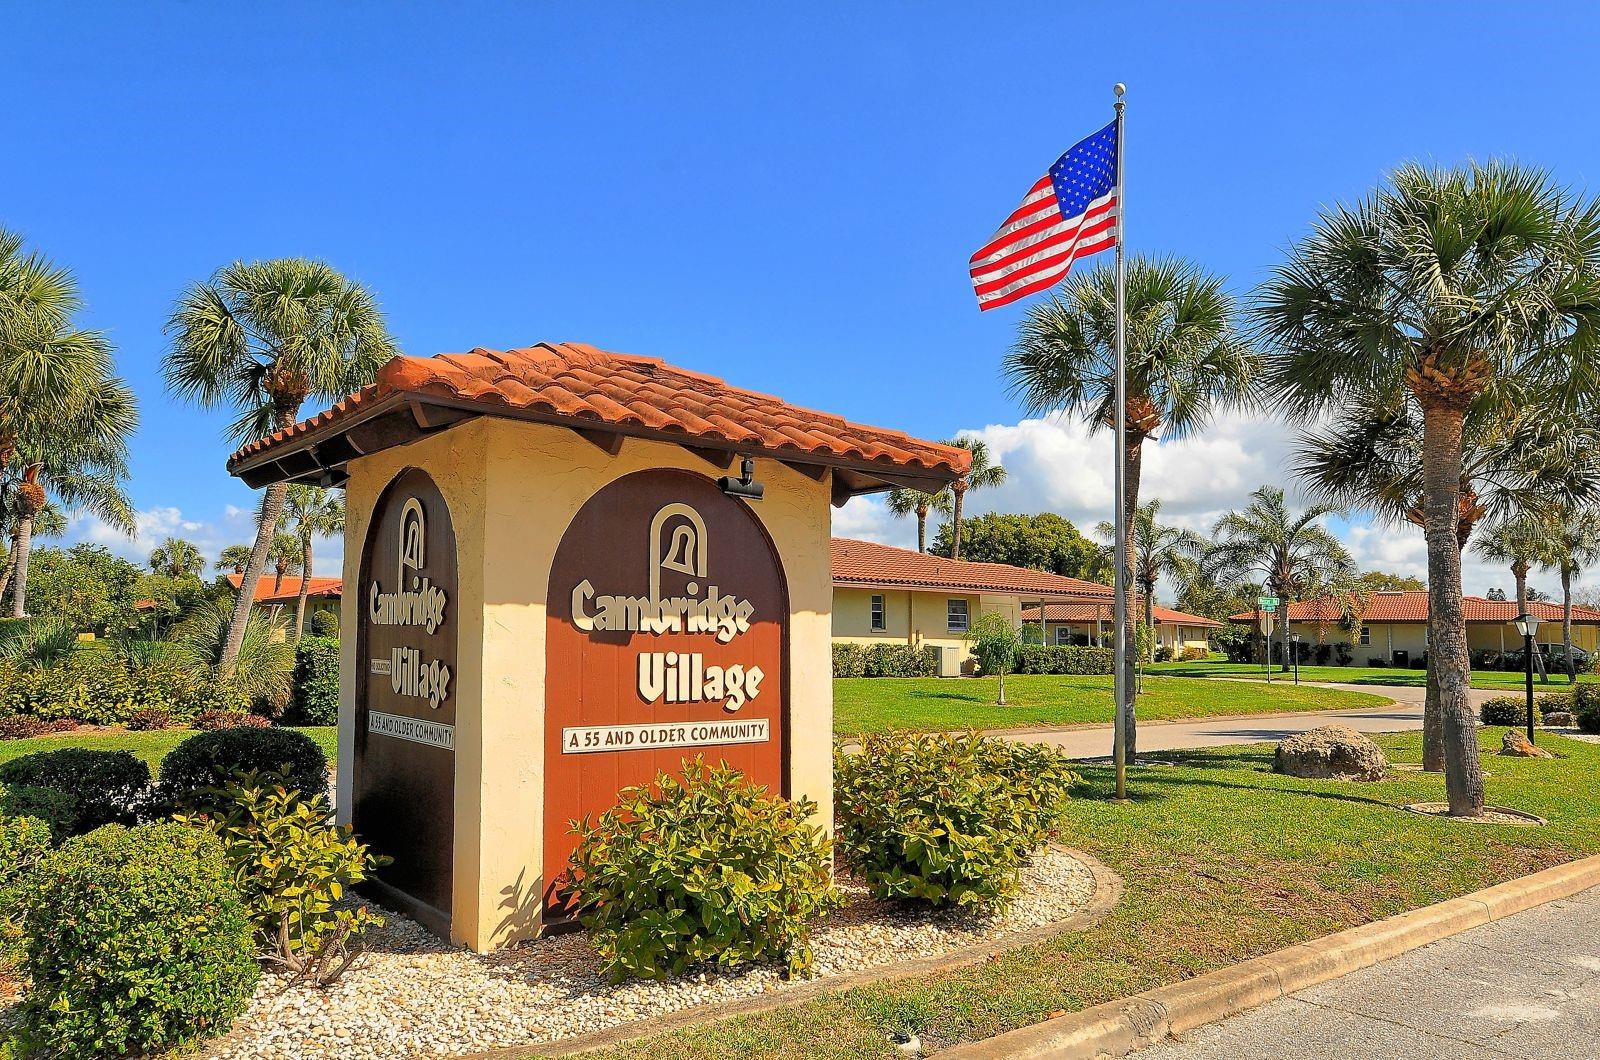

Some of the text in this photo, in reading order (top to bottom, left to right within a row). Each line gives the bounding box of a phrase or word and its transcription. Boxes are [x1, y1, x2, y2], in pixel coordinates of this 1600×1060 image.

[370, 576, 446, 635] Cambridge
[572, 579, 754, 643] Cambridge
[392, 646, 450, 709] Village
[638, 651, 765, 711] Village
[370, 714, 453, 745] A 55 AND OLDER COMMUNITY
[569, 723, 765, 748] A 55 AND OLDER COMMUNITY
